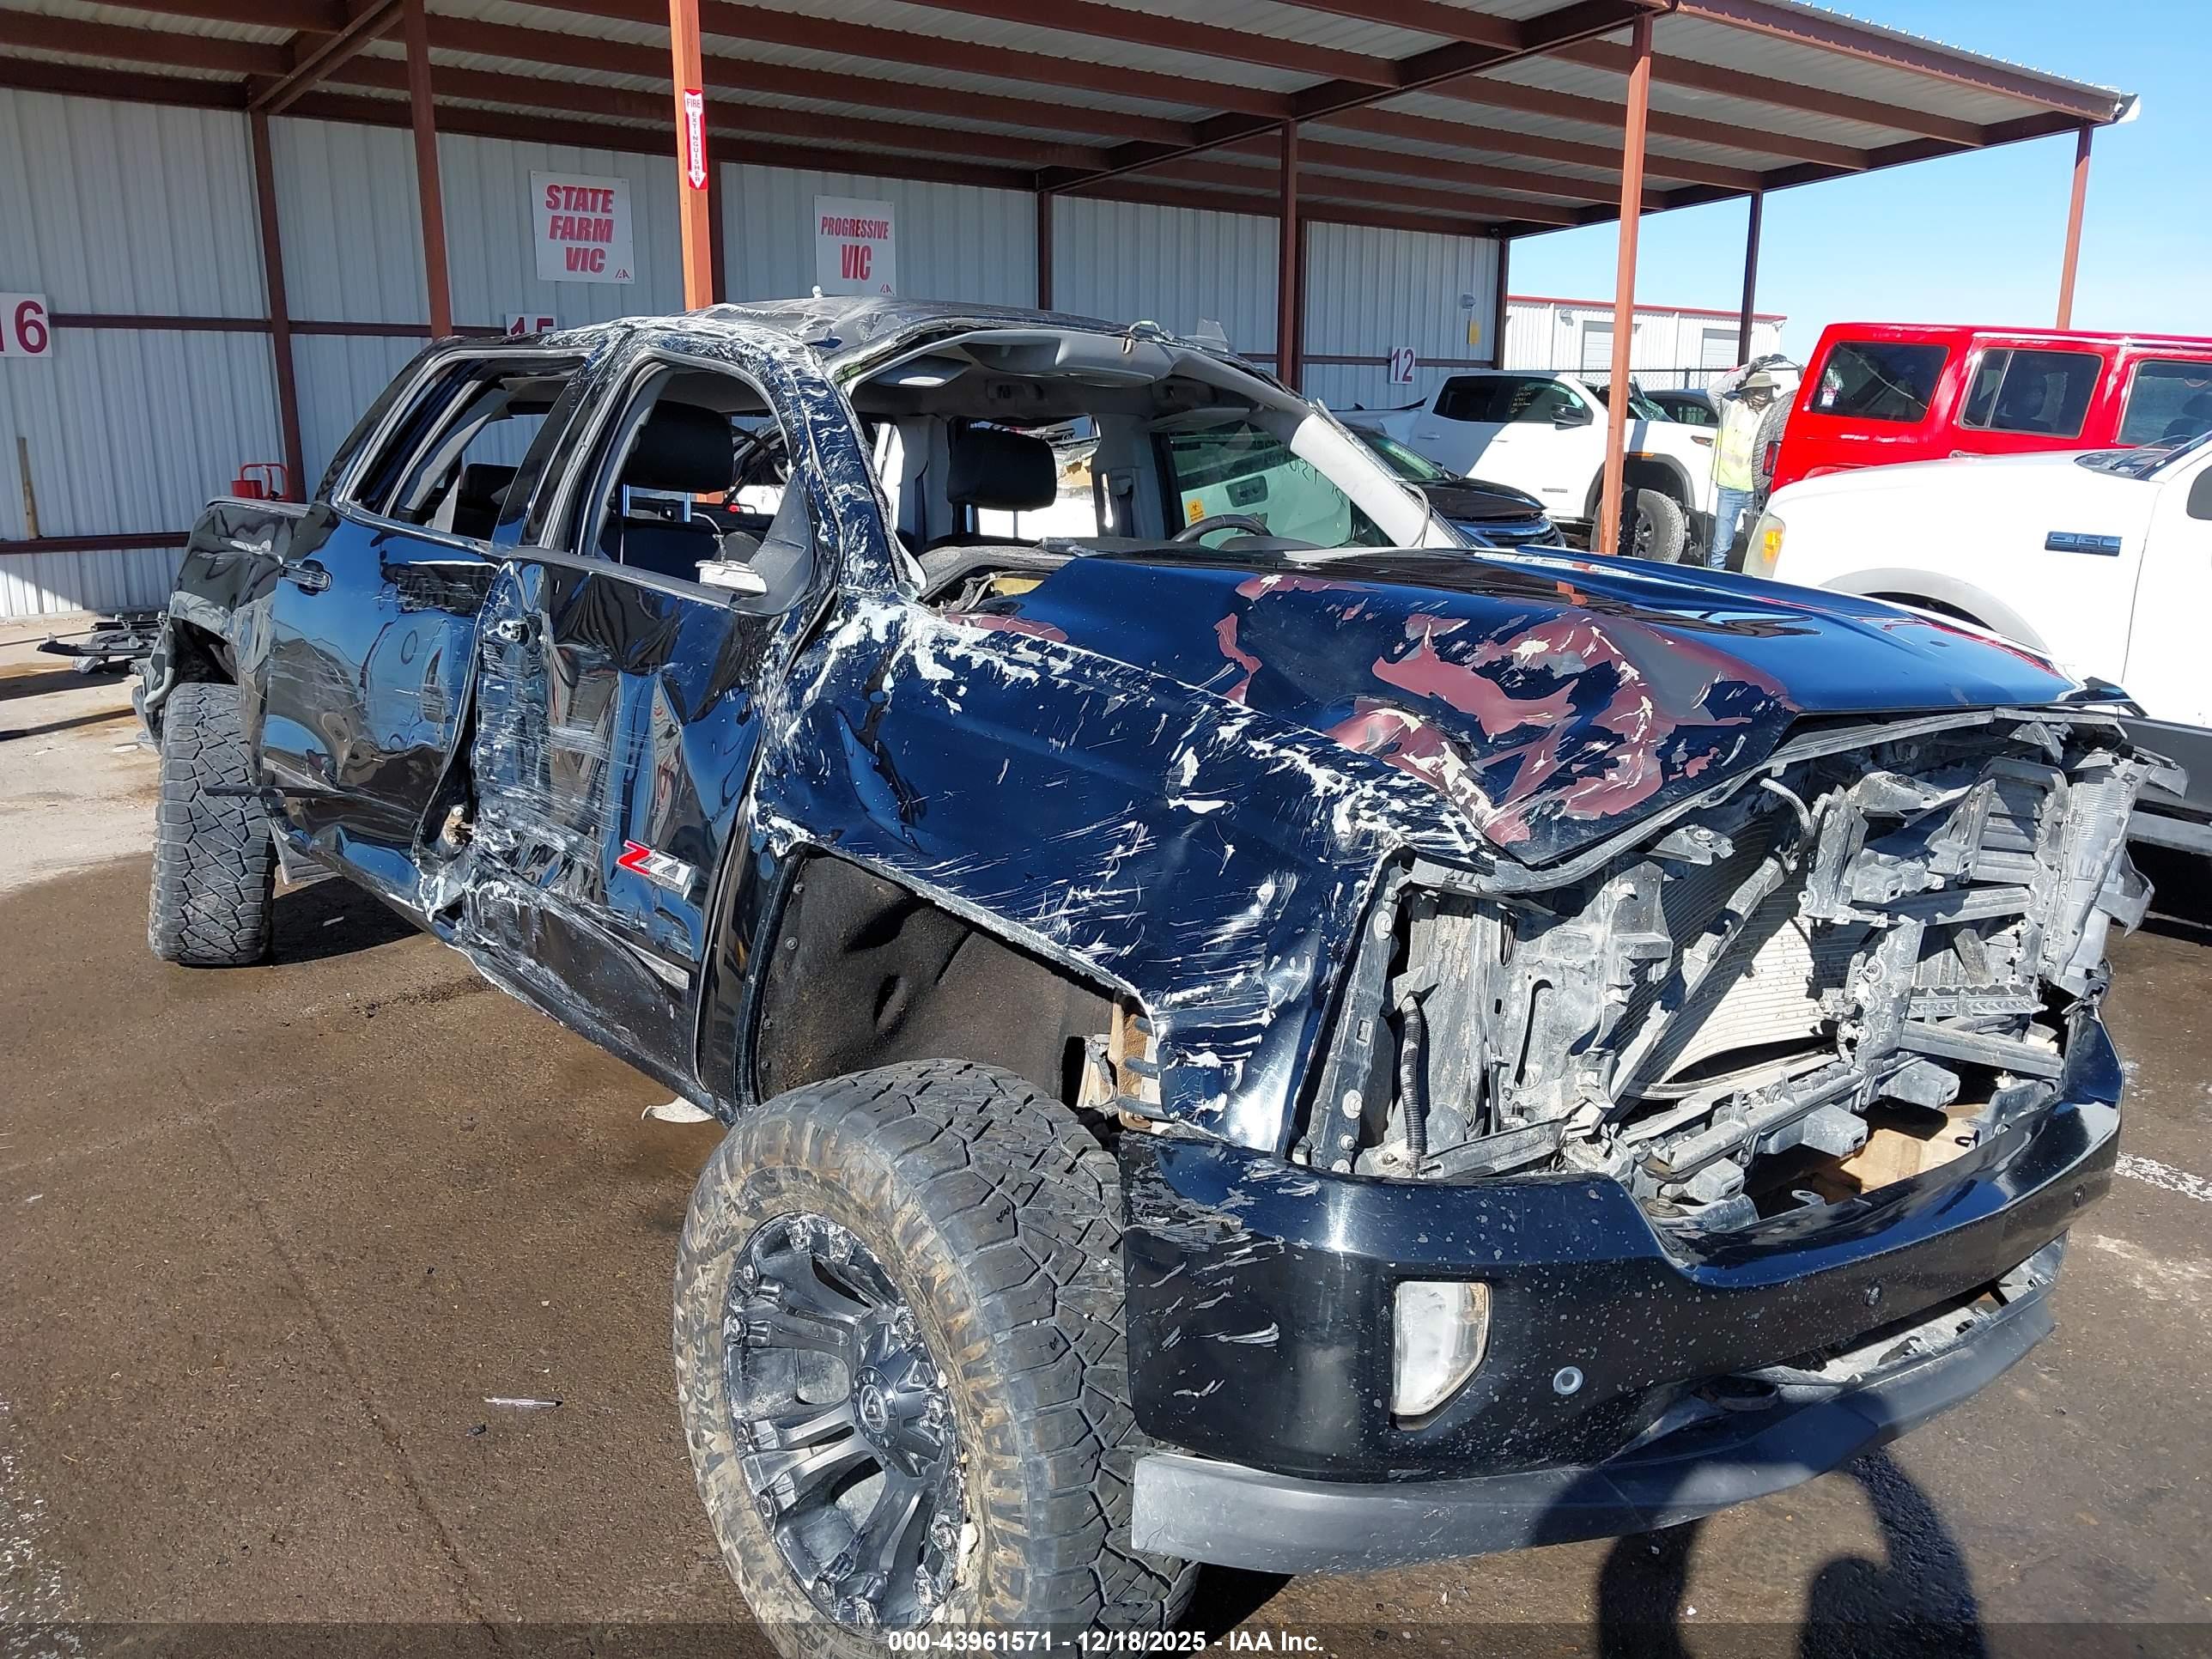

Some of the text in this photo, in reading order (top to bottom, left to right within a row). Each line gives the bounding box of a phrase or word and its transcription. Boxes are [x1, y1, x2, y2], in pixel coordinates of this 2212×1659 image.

[687, 98, 701, 108] FIRE
[545, 184, 615, 214] STATE
[549, 215, 614, 244] FARM
[821, 216, 889, 240] PROGRESSIVE
[566, 246, 606, 274] VIC
[842, 244, 872, 281] VIC
[0, 300, 47, 354] 6
[1392, 348, 1414, 382] 12
[616, 839, 693, 888] Z71
